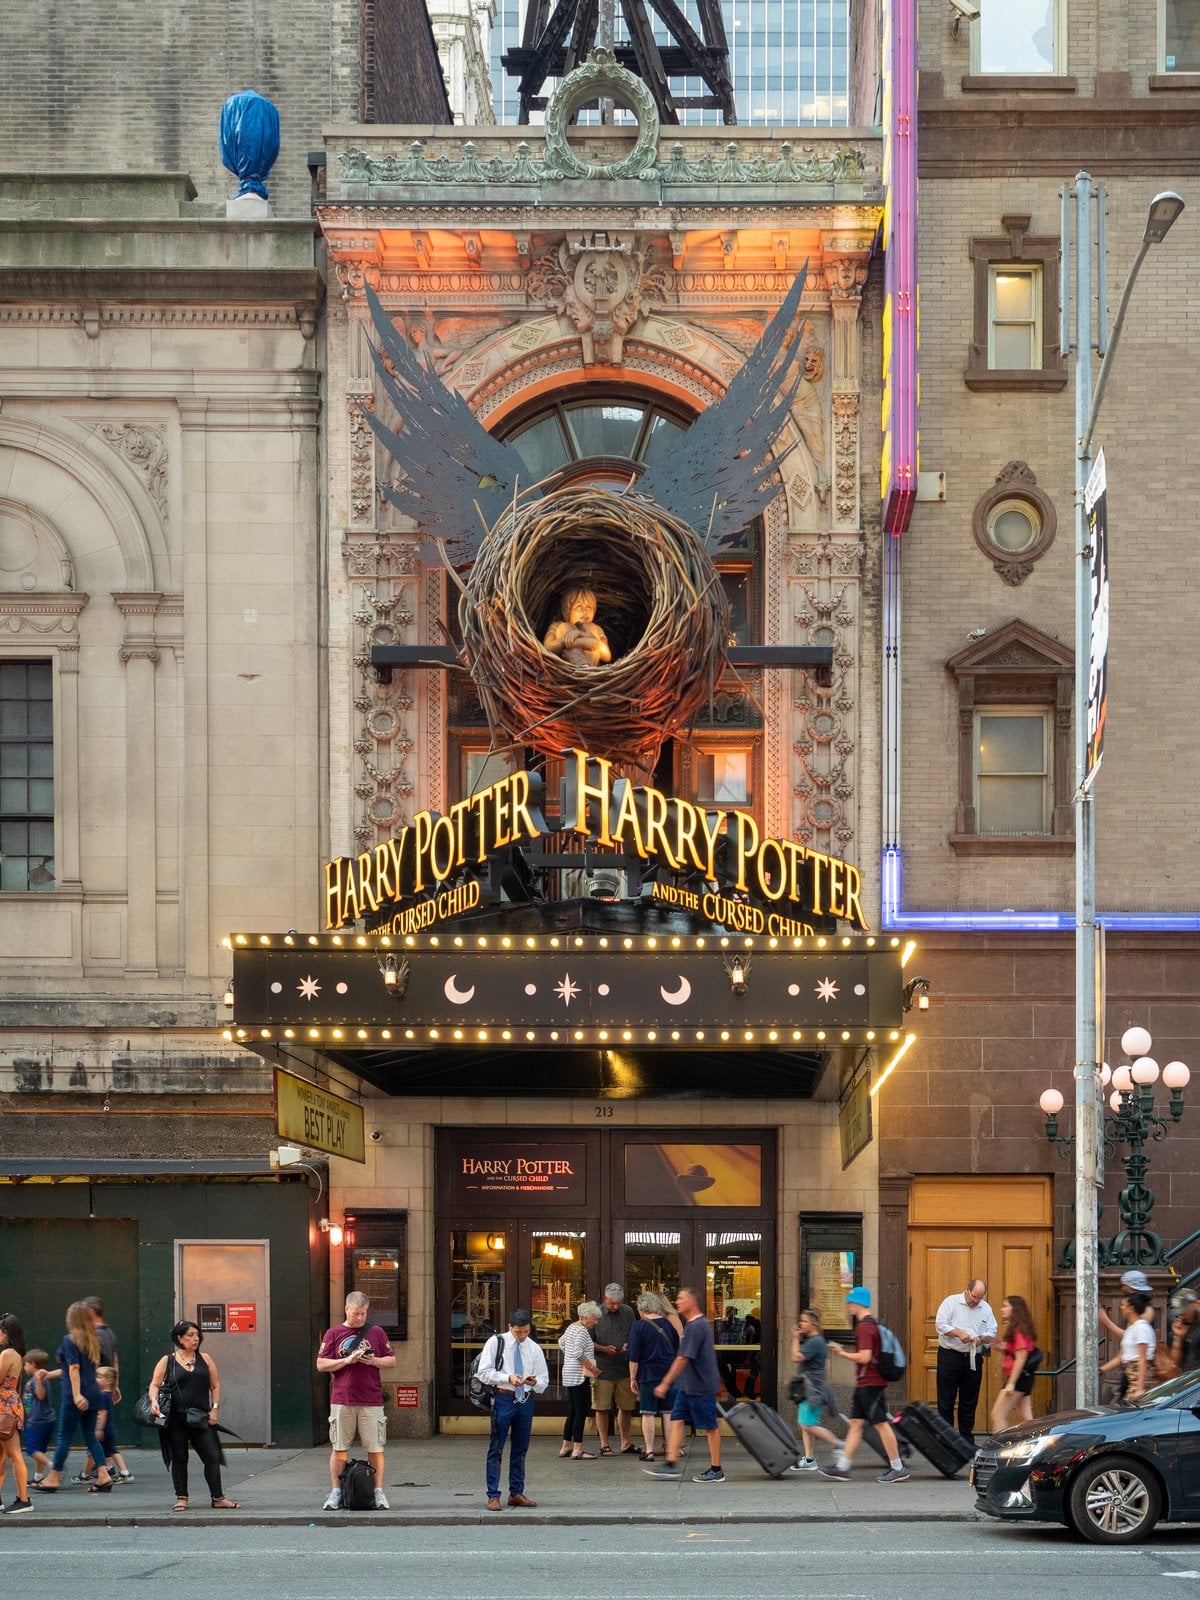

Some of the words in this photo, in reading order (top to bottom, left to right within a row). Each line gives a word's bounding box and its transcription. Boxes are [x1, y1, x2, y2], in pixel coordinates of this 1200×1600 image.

[324, 826, 408, 930] HARRY
[413, 770, 541, 894] POTTER
[572, 748, 726, 882] HARRY
[734, 810, 870, 931] POTTER
[392, 899, 436, 935] CURSED
[439, 880, 480, 919] CHILD
[651, 882, 677, 902] AND
[678, 891, 699, 910] THE
[702, 893, 765, 934] CURSED
[768, 914, 815, 936] CHILD
[304, 1105, 325, 1144] BEST
[326, 1114, 346, 1150] PLAY
[595, 1106, 614, 1118] 213
[462, 1159, 512, 1174] HARRY
[516, 1158, 574, 1175] POTTER
